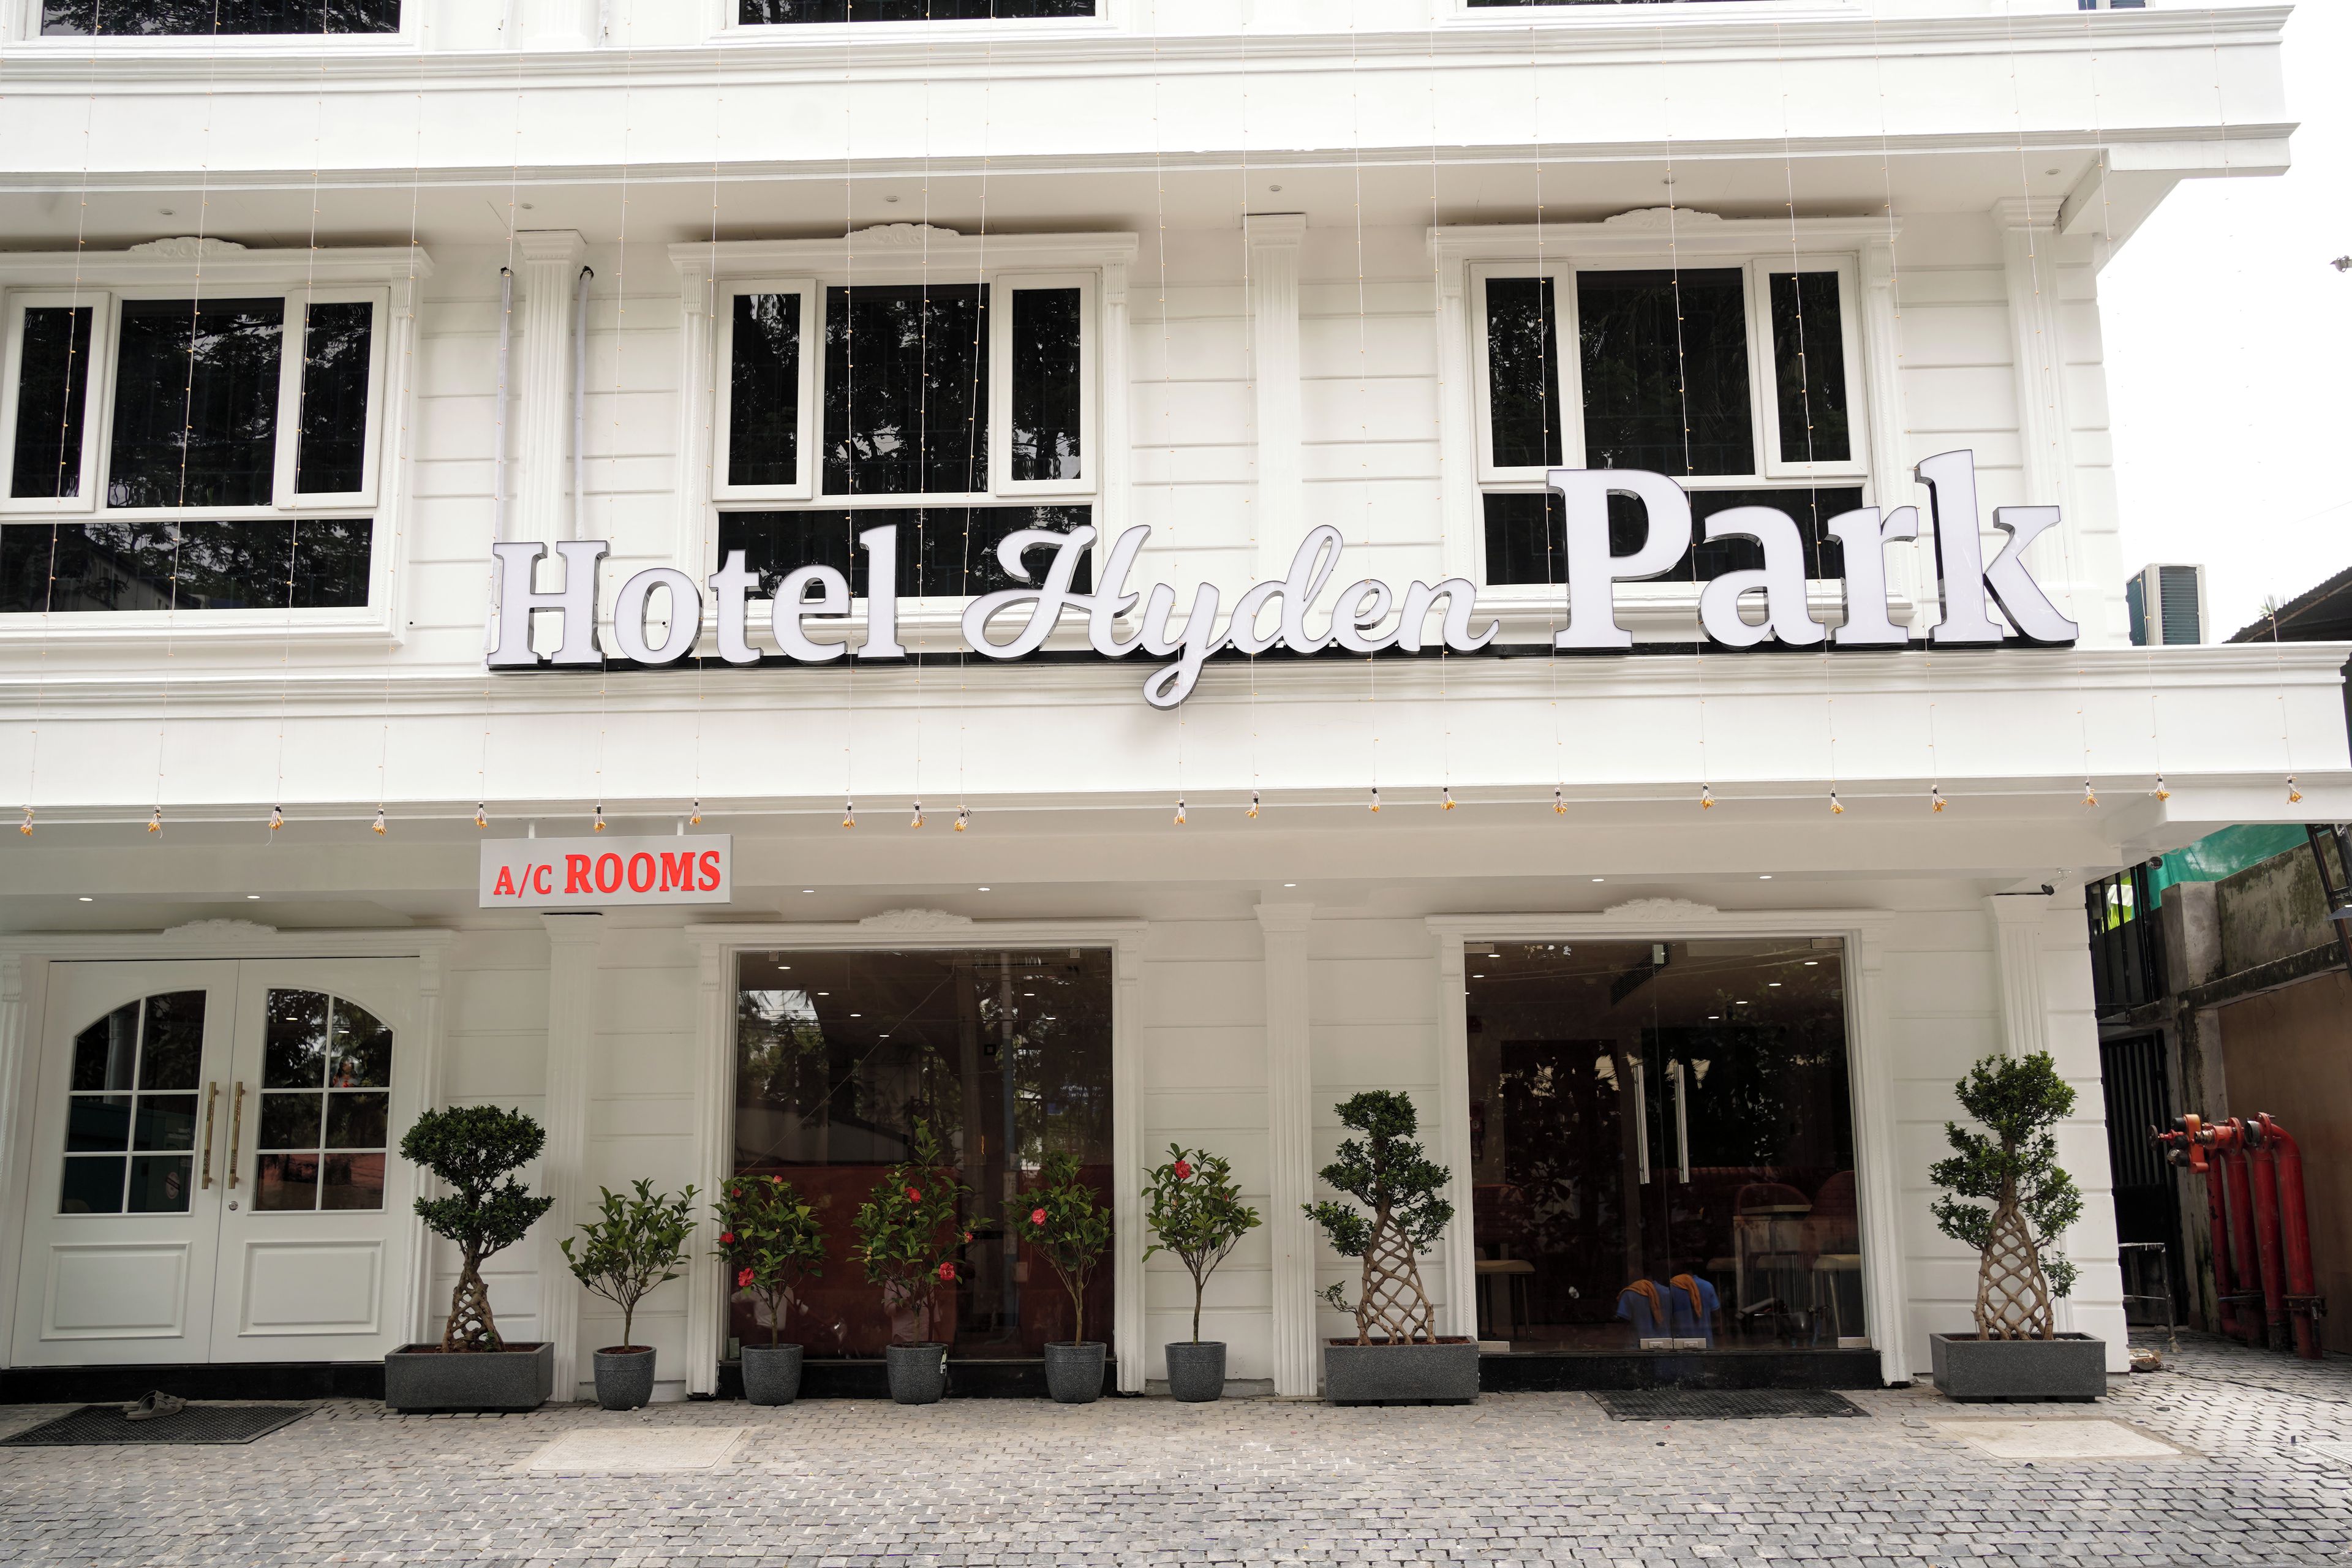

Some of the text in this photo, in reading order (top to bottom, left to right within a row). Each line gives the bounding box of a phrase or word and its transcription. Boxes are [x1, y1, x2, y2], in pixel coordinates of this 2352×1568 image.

[488, 448, 2079, 710] Hotel Hyden Park
[494, 851, 721, 898] A/C ROOMS
